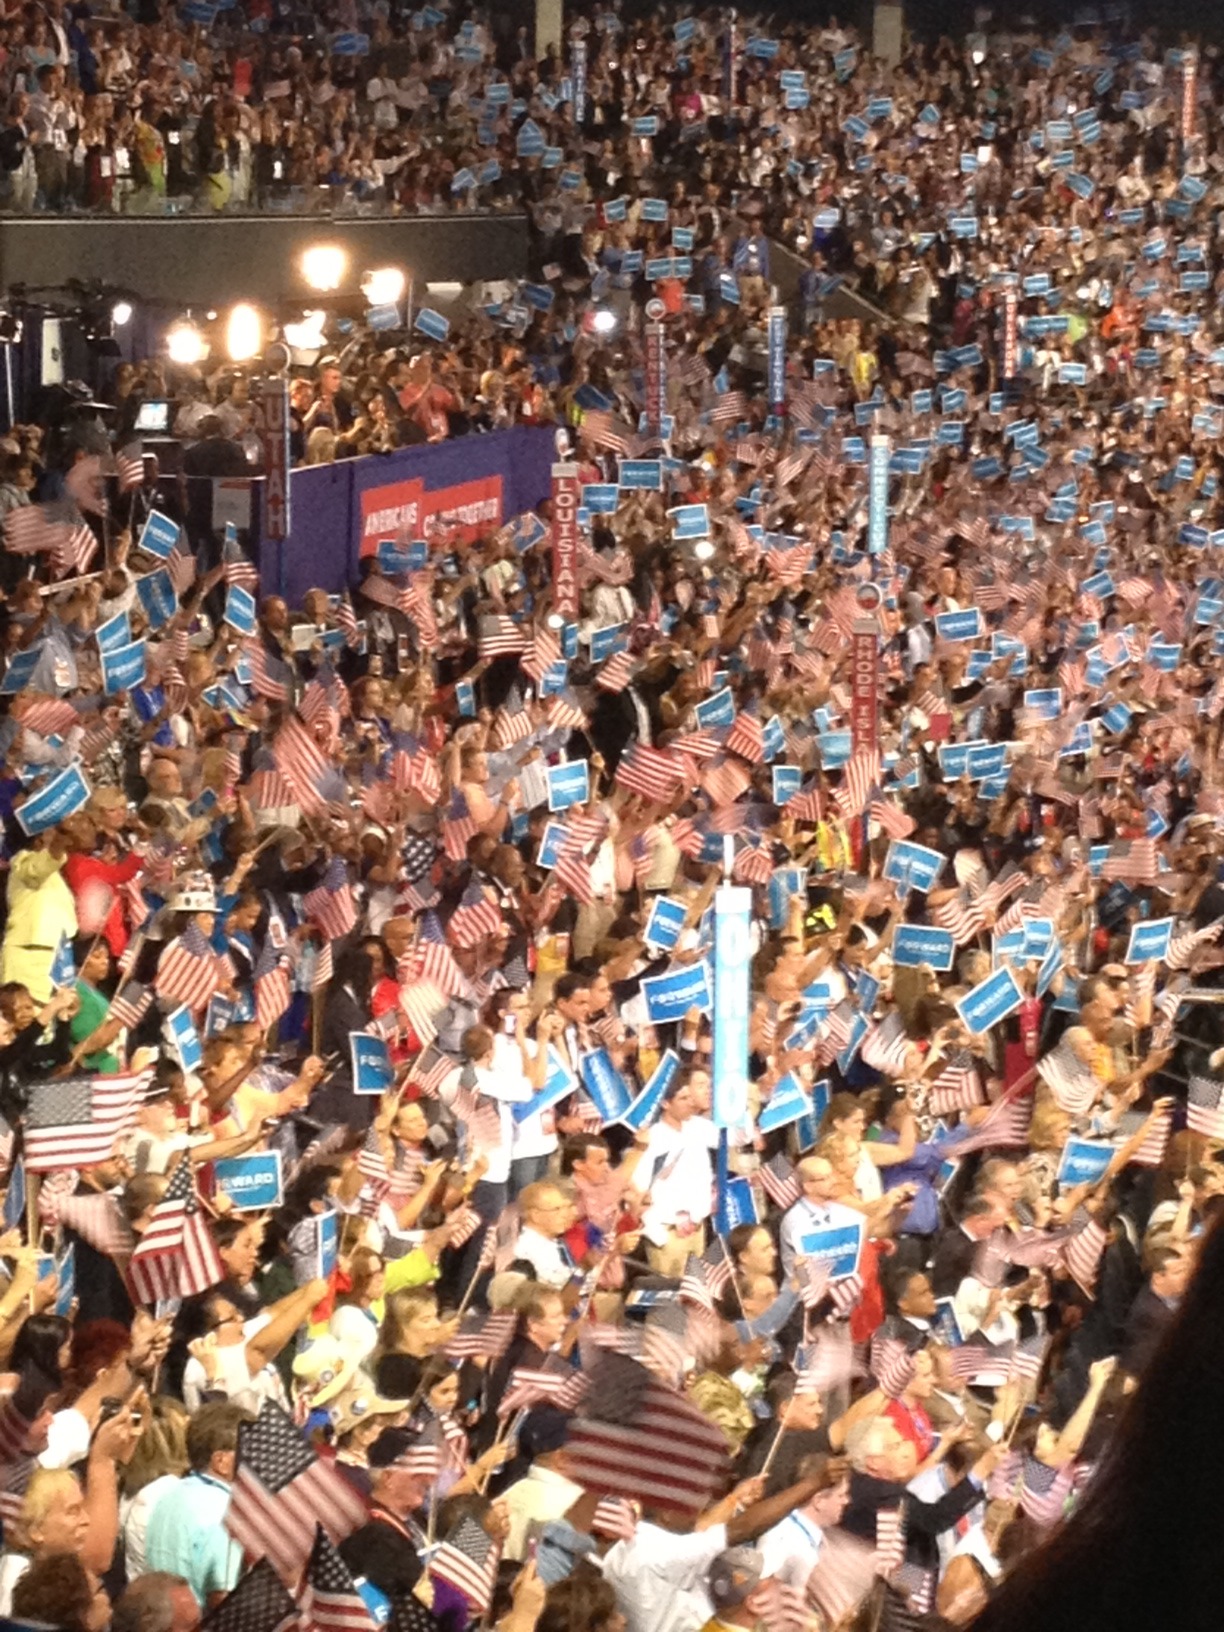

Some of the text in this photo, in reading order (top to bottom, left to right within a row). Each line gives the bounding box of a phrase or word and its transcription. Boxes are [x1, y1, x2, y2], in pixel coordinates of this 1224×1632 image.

[647, 335, 659, 427] KENTUCK
[267, 398, 284, 537] UTAH
[556, 479, 575, 613] LOUISIANA
[855, 636, 871, 754] RHODE ISLA
[719, 918, 745, 1123] OHIO
